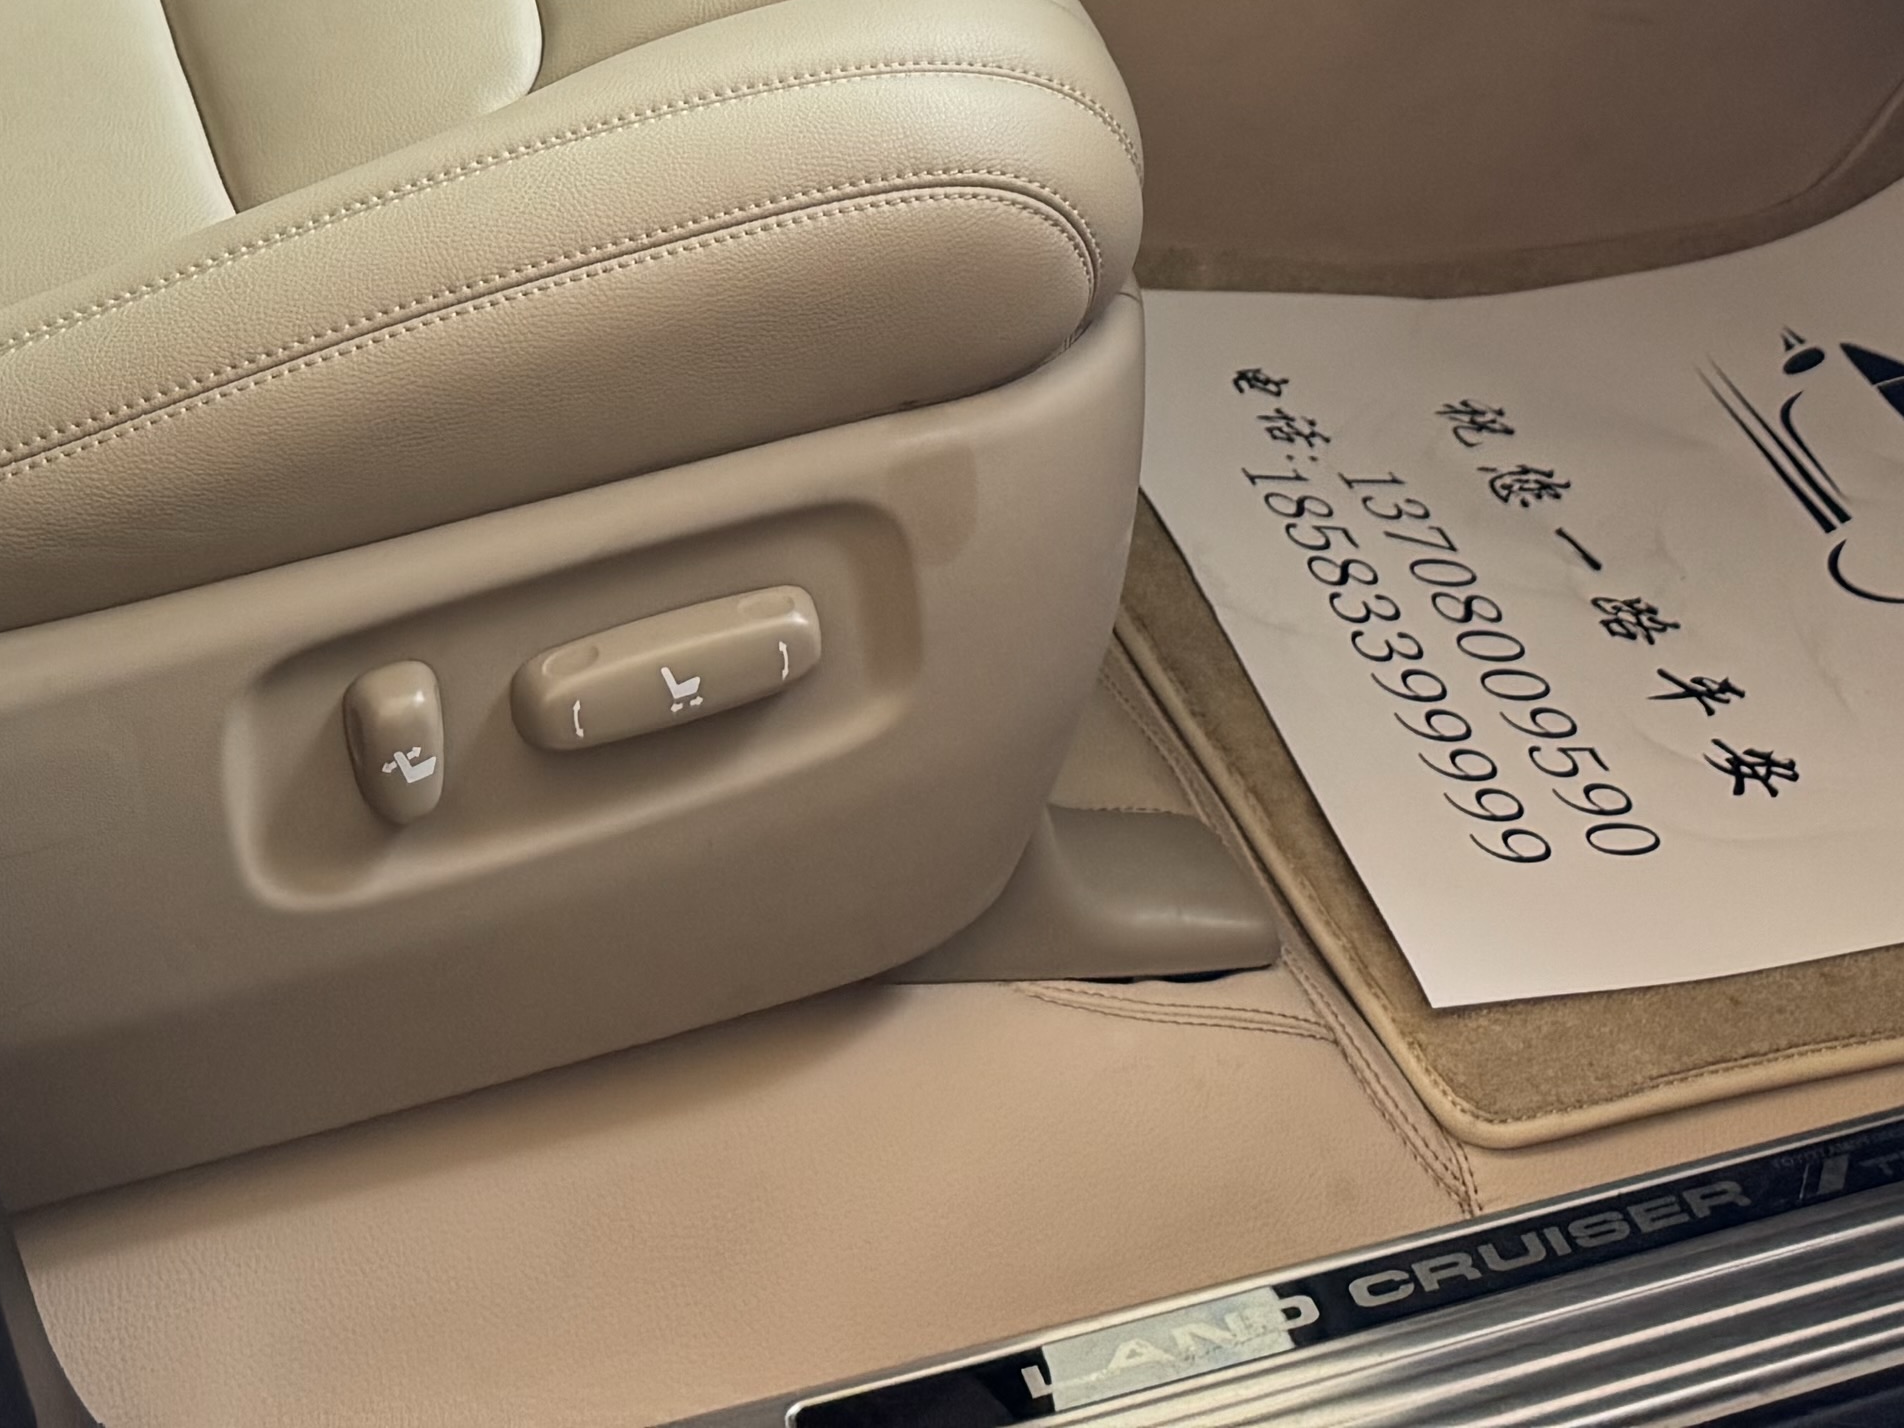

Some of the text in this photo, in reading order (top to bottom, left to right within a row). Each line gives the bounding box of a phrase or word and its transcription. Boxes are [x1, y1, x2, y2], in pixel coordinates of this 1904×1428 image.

[1241, 466, 1553, 865] 18583399999
[1337, 470, 1662, 857] 13708009590
[1435, 398, 1801, 800] 祝您一路平安
[1348, 1180, 1752, 1308] CRUISER
